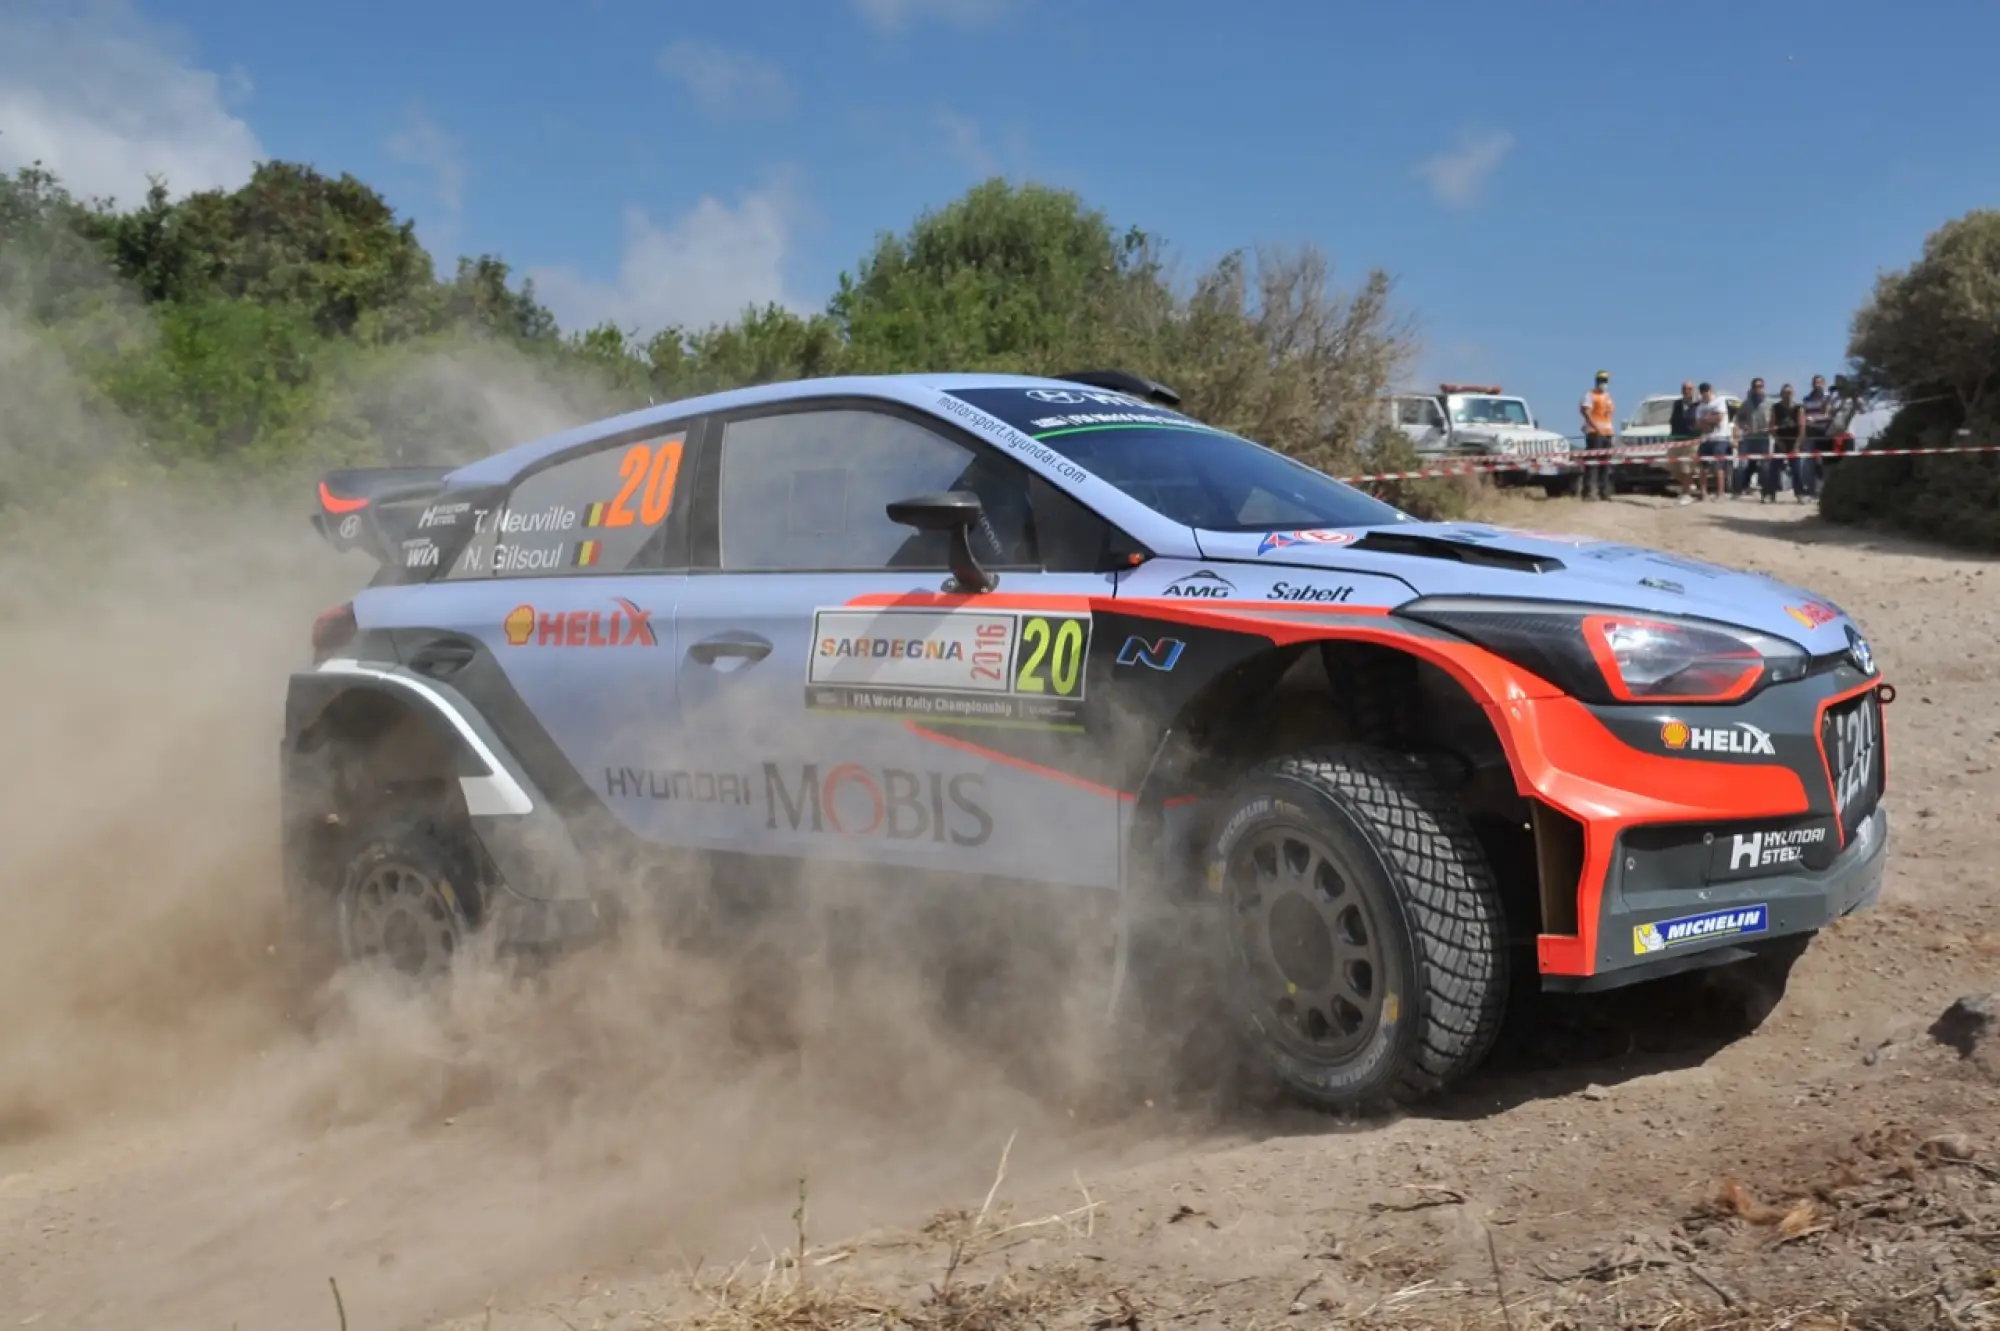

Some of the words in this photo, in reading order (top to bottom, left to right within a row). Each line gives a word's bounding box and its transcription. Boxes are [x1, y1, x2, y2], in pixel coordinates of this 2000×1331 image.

[937, 395, 1088, 485] motorsport.hyundai.com
[604, 439, 685, 527] 20
[474, 509, 489, 534] T.
[494, 505, 576, 533] Neuville
[464, 545, 483, 571] N.
[491, 542, 564, 570] Gilsoul
[1162, 585, 1229, 598] AMG
[1266, 581, 1355, 602] Sabelt
[537, 597, 658, 647] HELIX
[819, 638, 964, 662] SARDEGNA
[970, 623, 1008, 681] 2016
[1016, 616, 1083, 696] 20
[852, 693, 871, 707] FIA
[873, 693, 903, 709] World
[905, 696, 932, 713] Rally
[935, 697, 1012, 717] Championship
[1691, 721, 1776, 755] HELIX
[605, 766, 752, 805] HYUNDAI
[762, 760, 994, 848] MOBIS
[1763, 827, 1826, 847] HYUNDAI
[1667, 910, 1761, 940] MICHELIN
